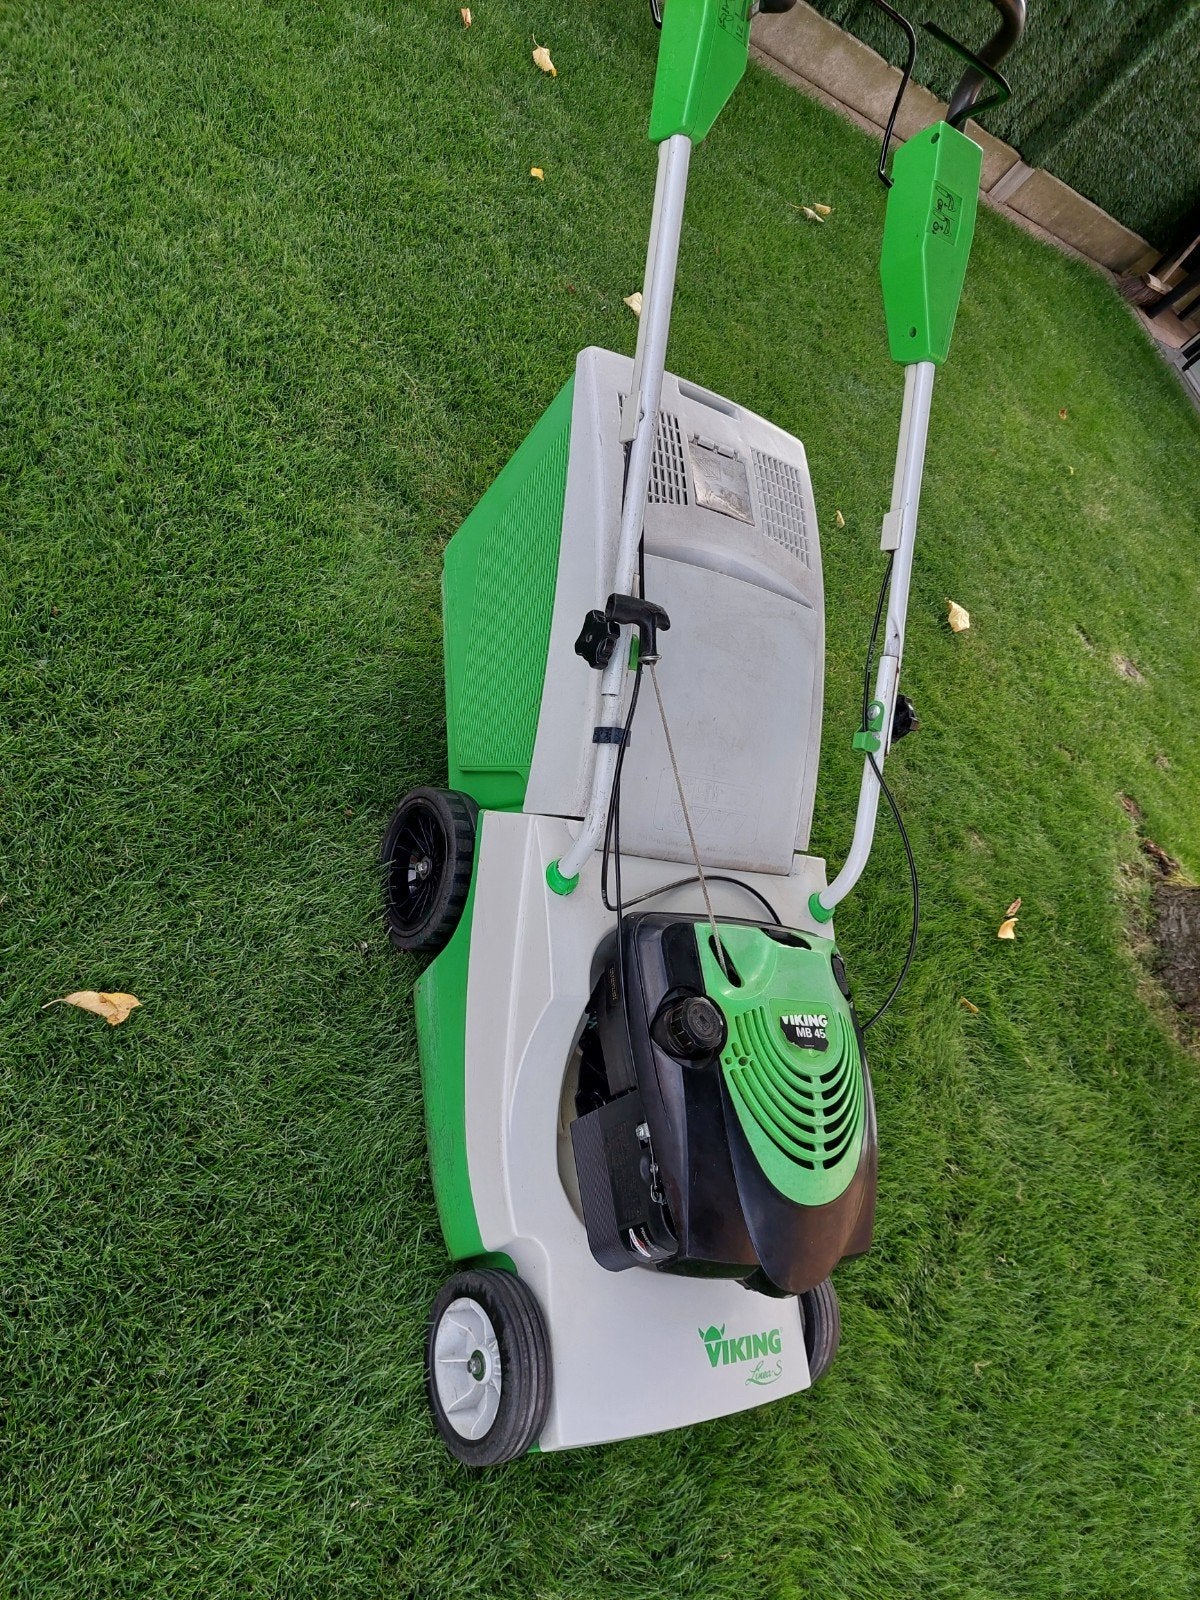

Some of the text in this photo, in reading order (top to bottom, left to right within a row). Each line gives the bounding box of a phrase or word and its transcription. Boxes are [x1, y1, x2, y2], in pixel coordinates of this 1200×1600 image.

[781, 1014, 828, 1028] VIKING
[795, 1026, 813, 1038] MB
[704, 1328, 782, 1368] VIKING
